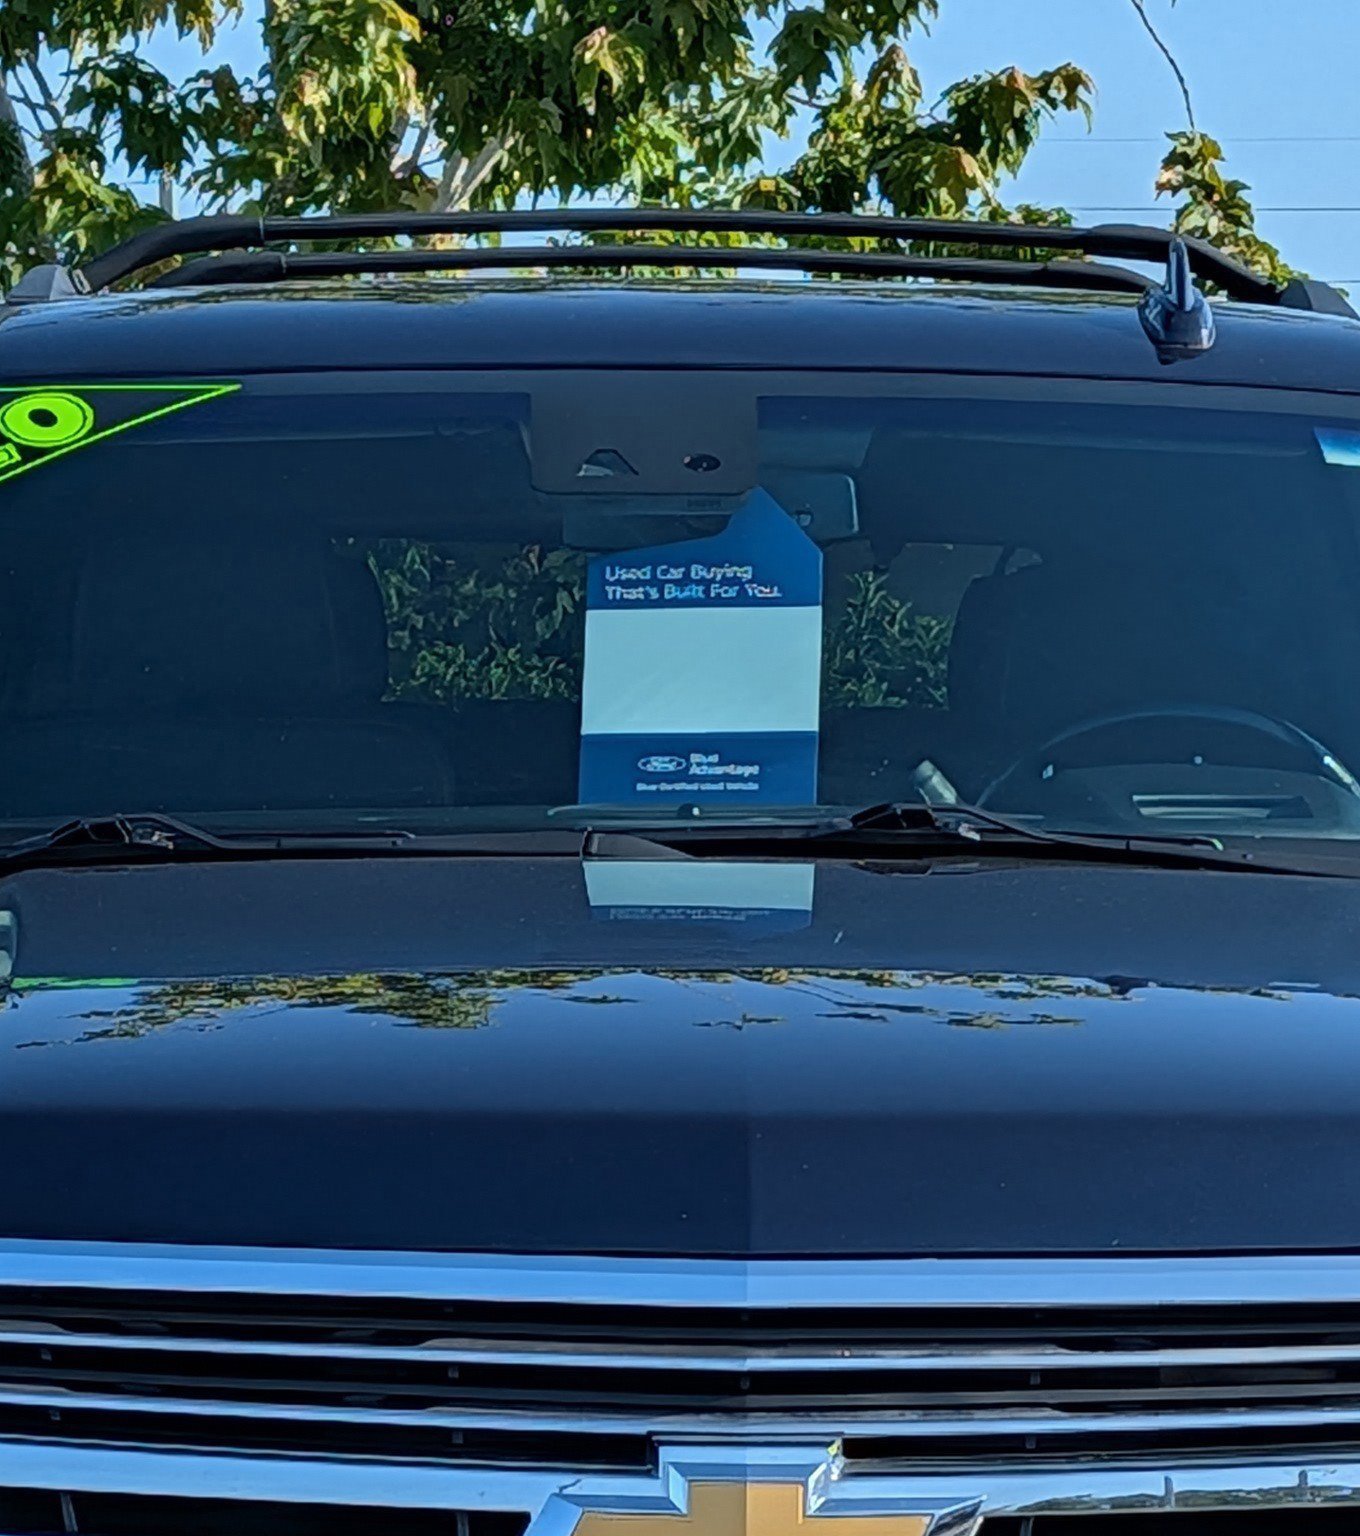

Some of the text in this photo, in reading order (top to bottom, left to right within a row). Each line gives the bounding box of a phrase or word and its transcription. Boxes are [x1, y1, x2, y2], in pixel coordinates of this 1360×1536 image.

[605, 563, 752, 581] Used Car Buying
[605, 586, 659, 600] That's
[664, 584, 705, 599] Built
[710, 584, 739, 598] For
